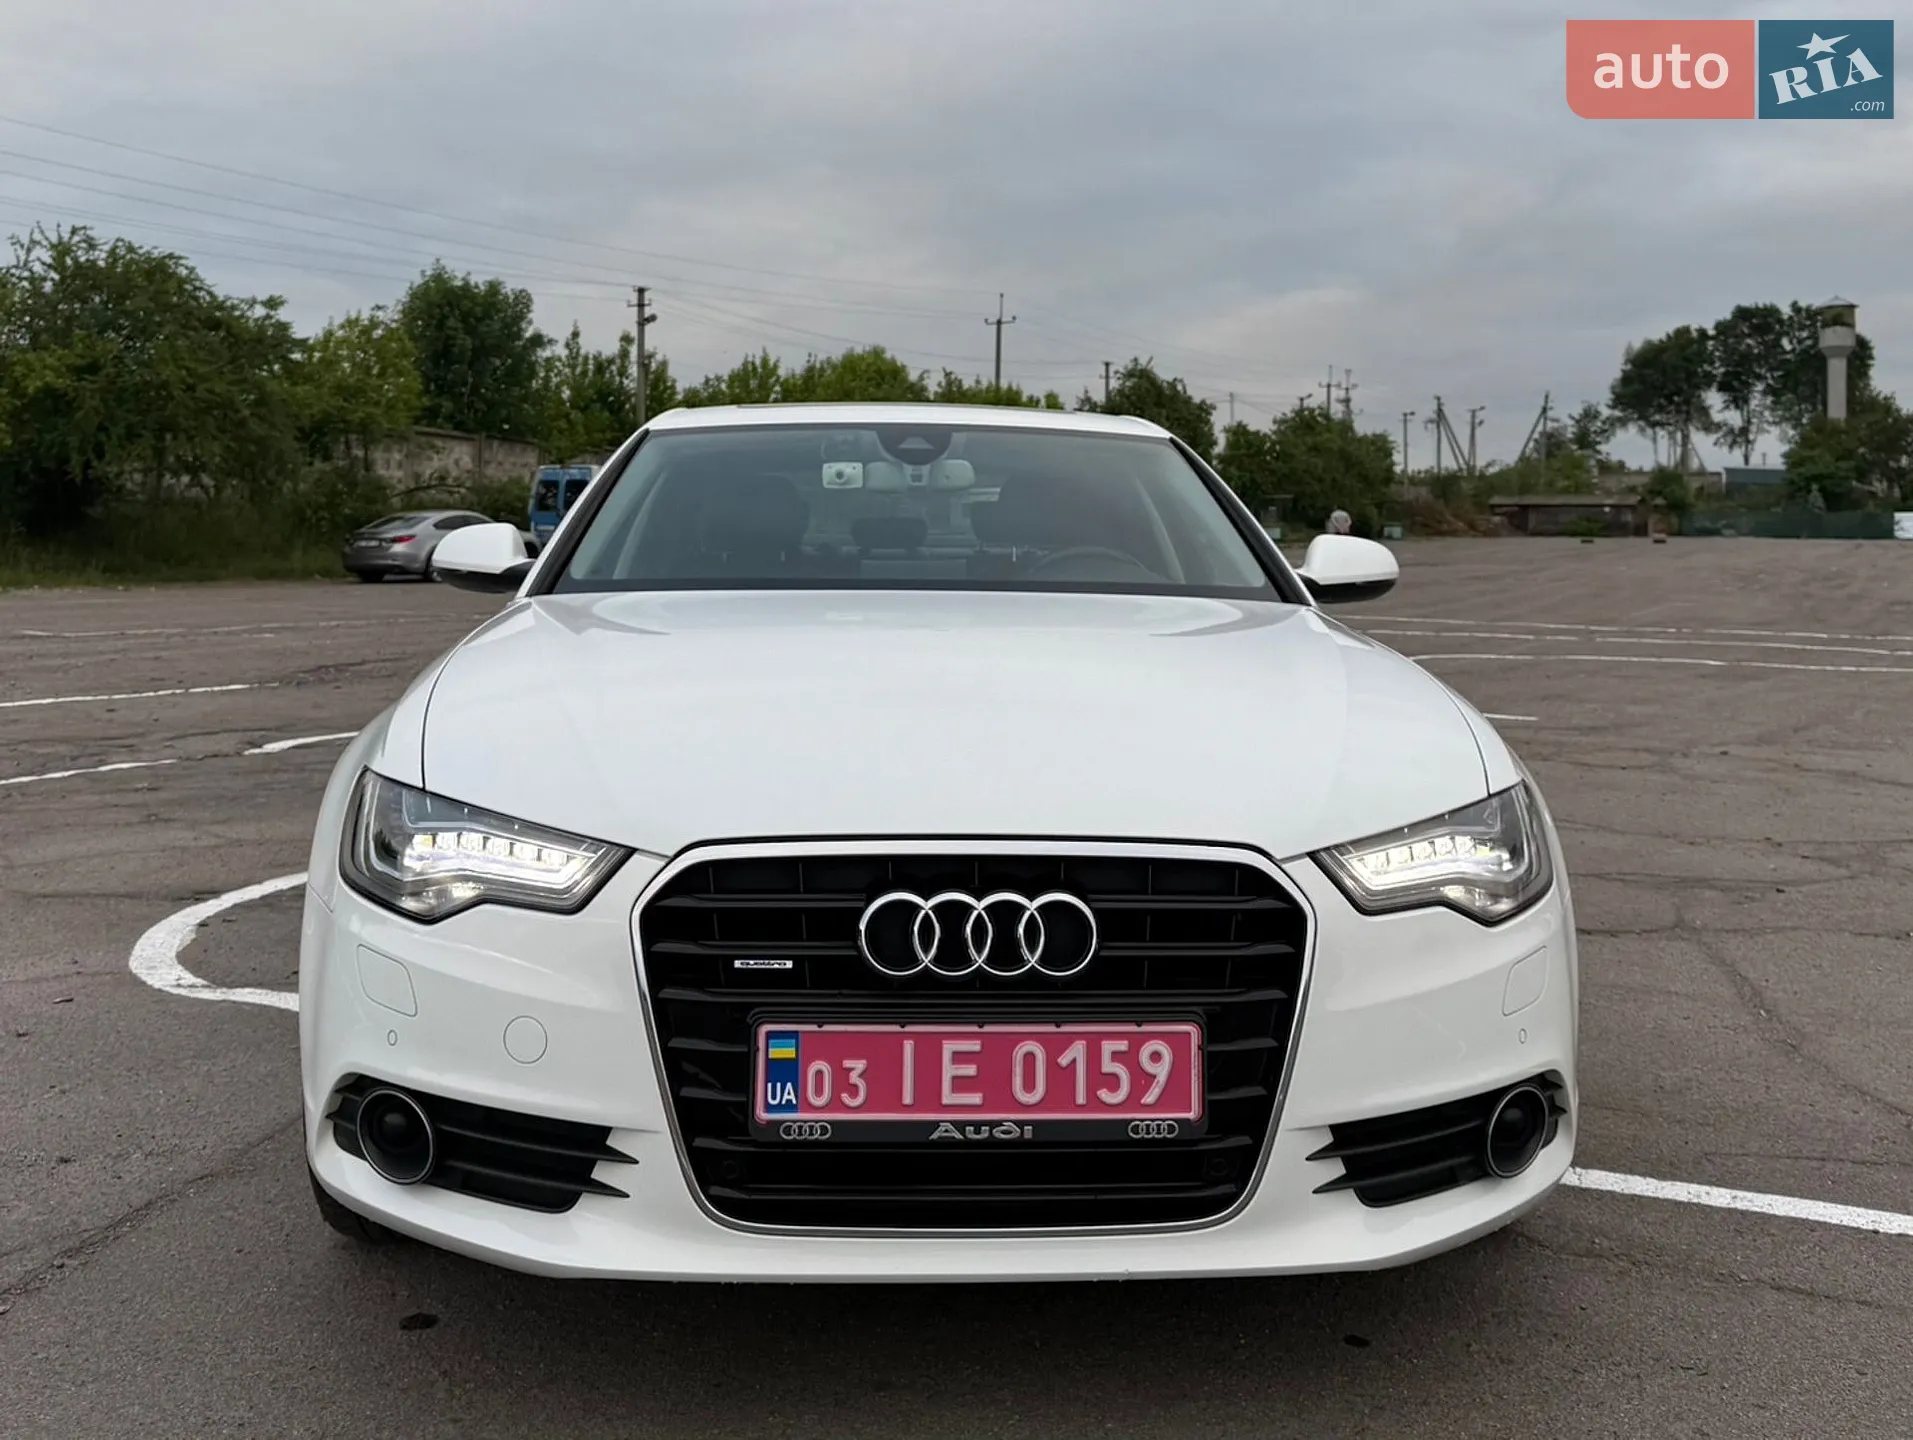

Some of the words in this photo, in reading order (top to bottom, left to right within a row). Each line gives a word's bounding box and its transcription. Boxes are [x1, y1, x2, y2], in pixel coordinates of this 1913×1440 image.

[805, 1059, 869, 1108] 03
[1012, 1039, 1174, 1106] 0159
[767, 1082, 797, 1105] UA
[928, 1122, 1033, 1141] Audi
